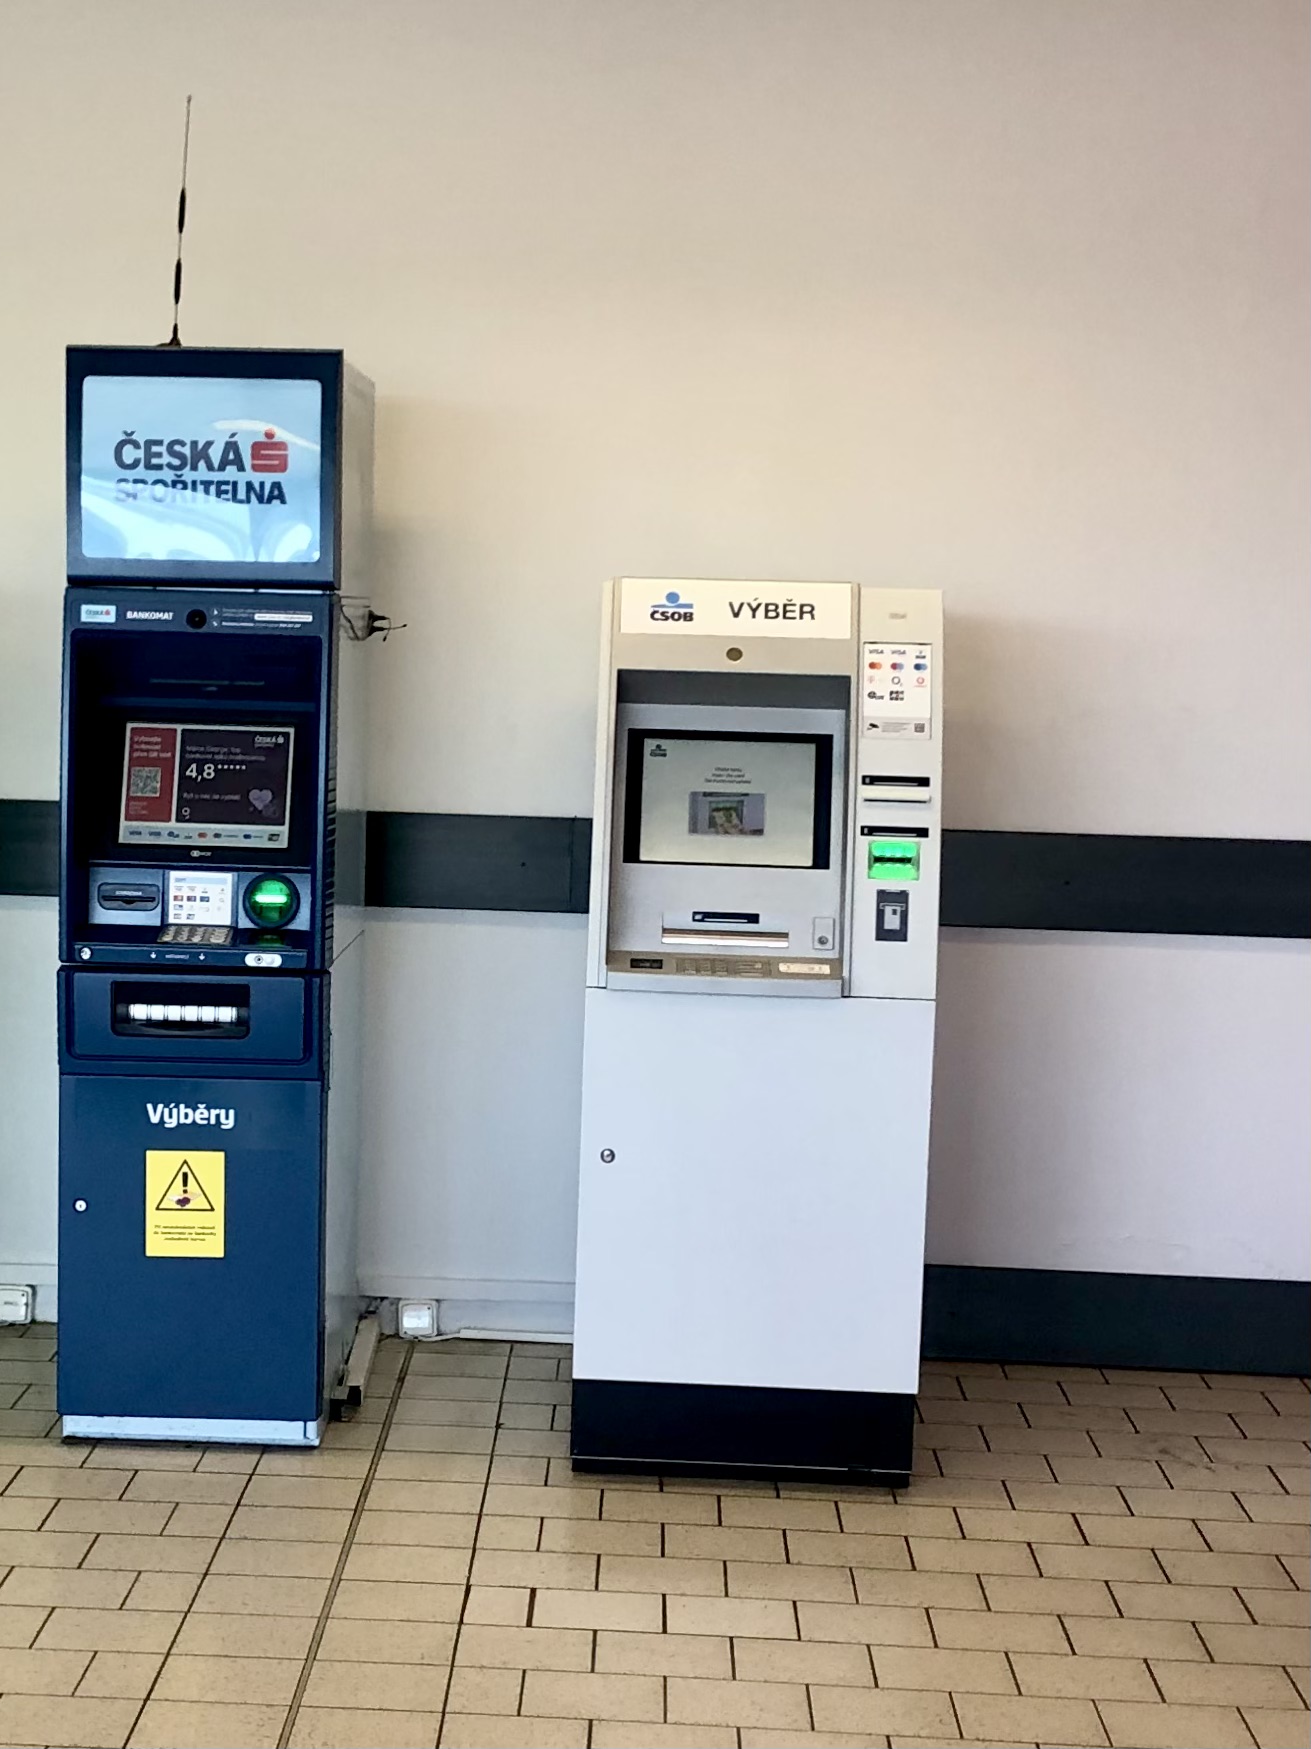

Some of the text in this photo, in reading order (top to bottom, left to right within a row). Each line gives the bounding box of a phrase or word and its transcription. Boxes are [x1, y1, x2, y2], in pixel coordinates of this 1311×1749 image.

[114, 430, 246, 473] ČESKÁ
[126, 610, 174, 621] BANKOMAT
[649, 608, 694, 622] ČSOB
[728, 597, 816, 621] VÝBĚR
[185, 762, 216, 783] 4,8
[146, 1103, 236, 1130] Výběry
